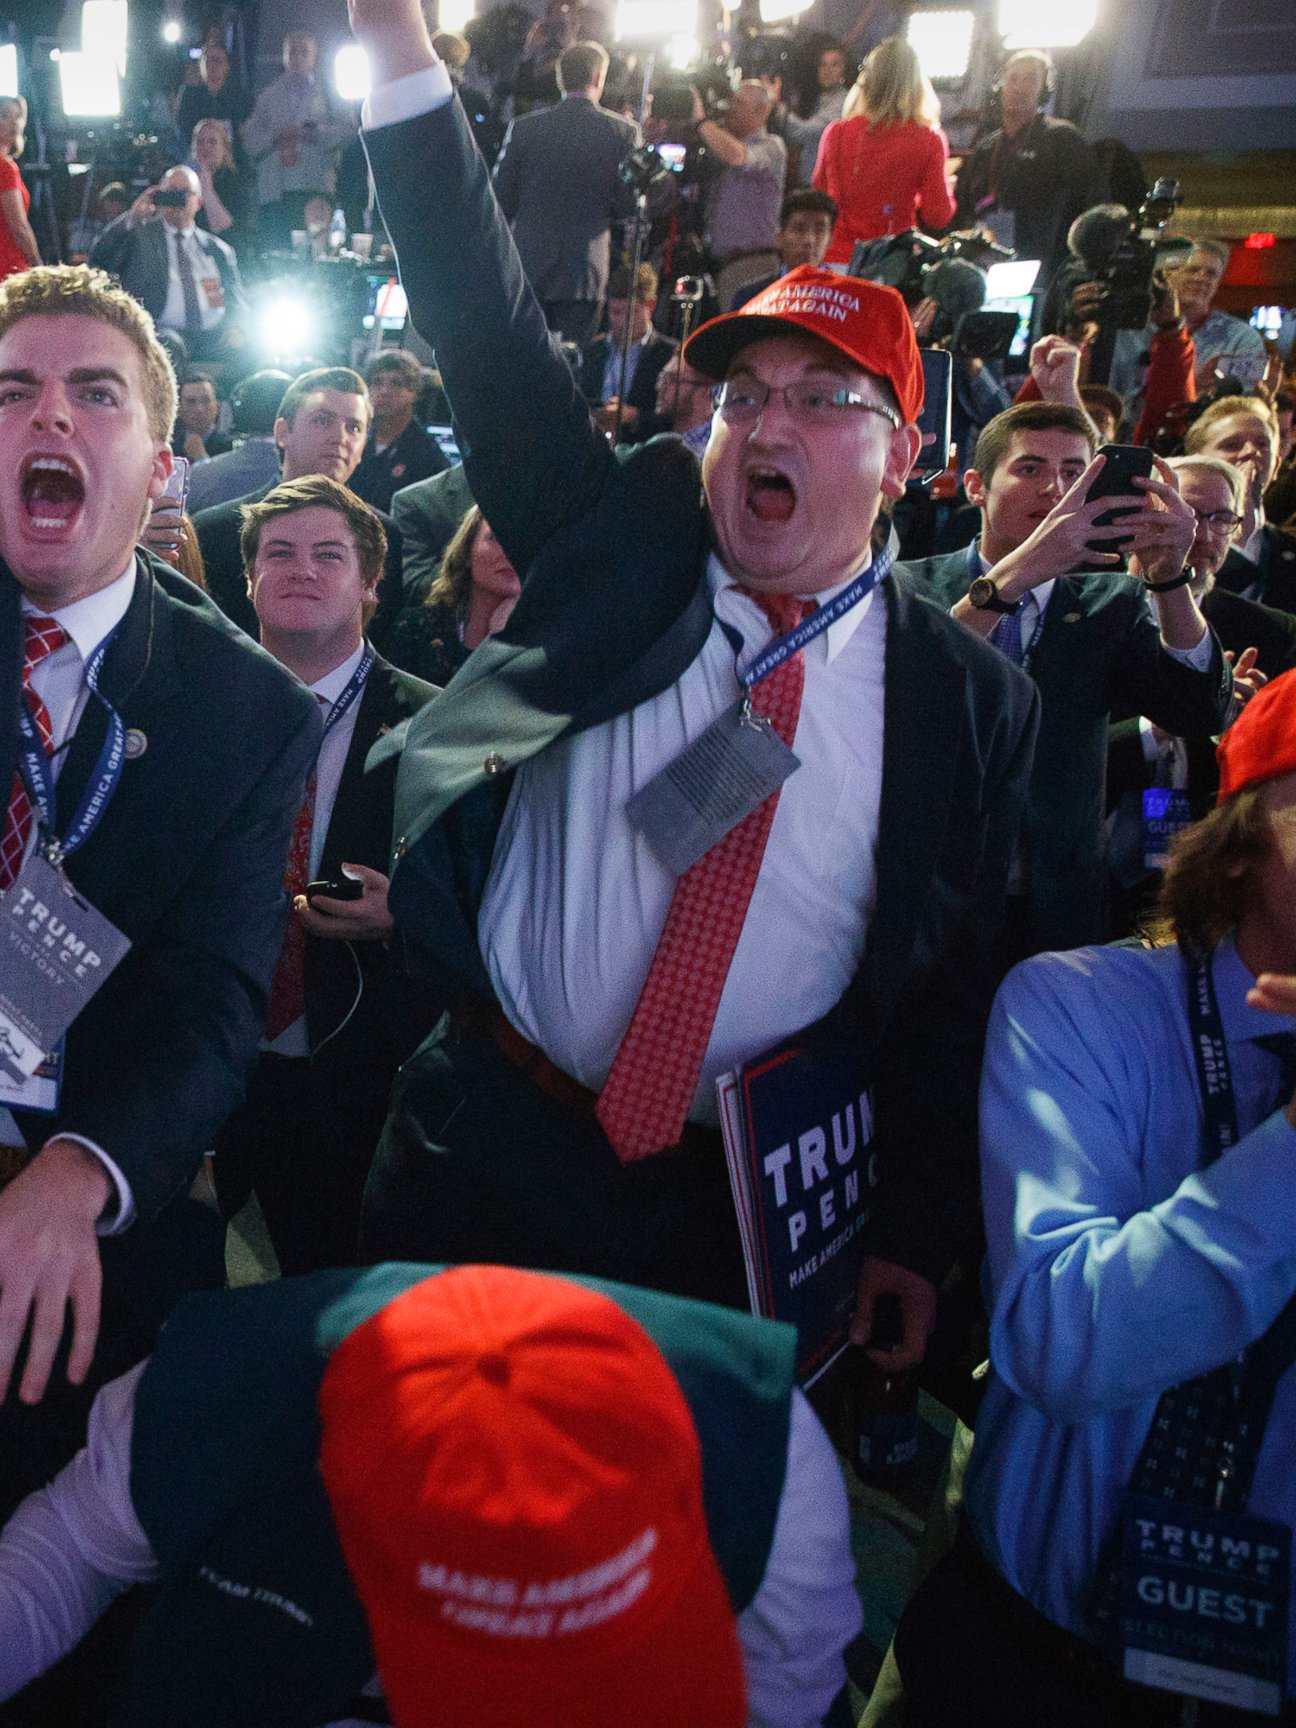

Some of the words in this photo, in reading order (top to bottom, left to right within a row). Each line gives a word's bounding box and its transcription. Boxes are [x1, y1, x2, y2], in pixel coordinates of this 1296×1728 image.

[789, 299, 847, 322] AGAIN
[25, 751, 46, 793] MAKE
[77, 774, 113, 835] AMERICA
[107, 729, 124, 771] GREAT
[11, 904, 88, 979] PENCE
[19, 886, 102, 968] TRUMP
[1199, 1033, 1221, 1095] TRUMP
[788, 1254, 819, 1290] MAKE
[1136, 1519, 1280, 1560] TRUMP
[1136, 1575, 1275, 1630] GUEST
